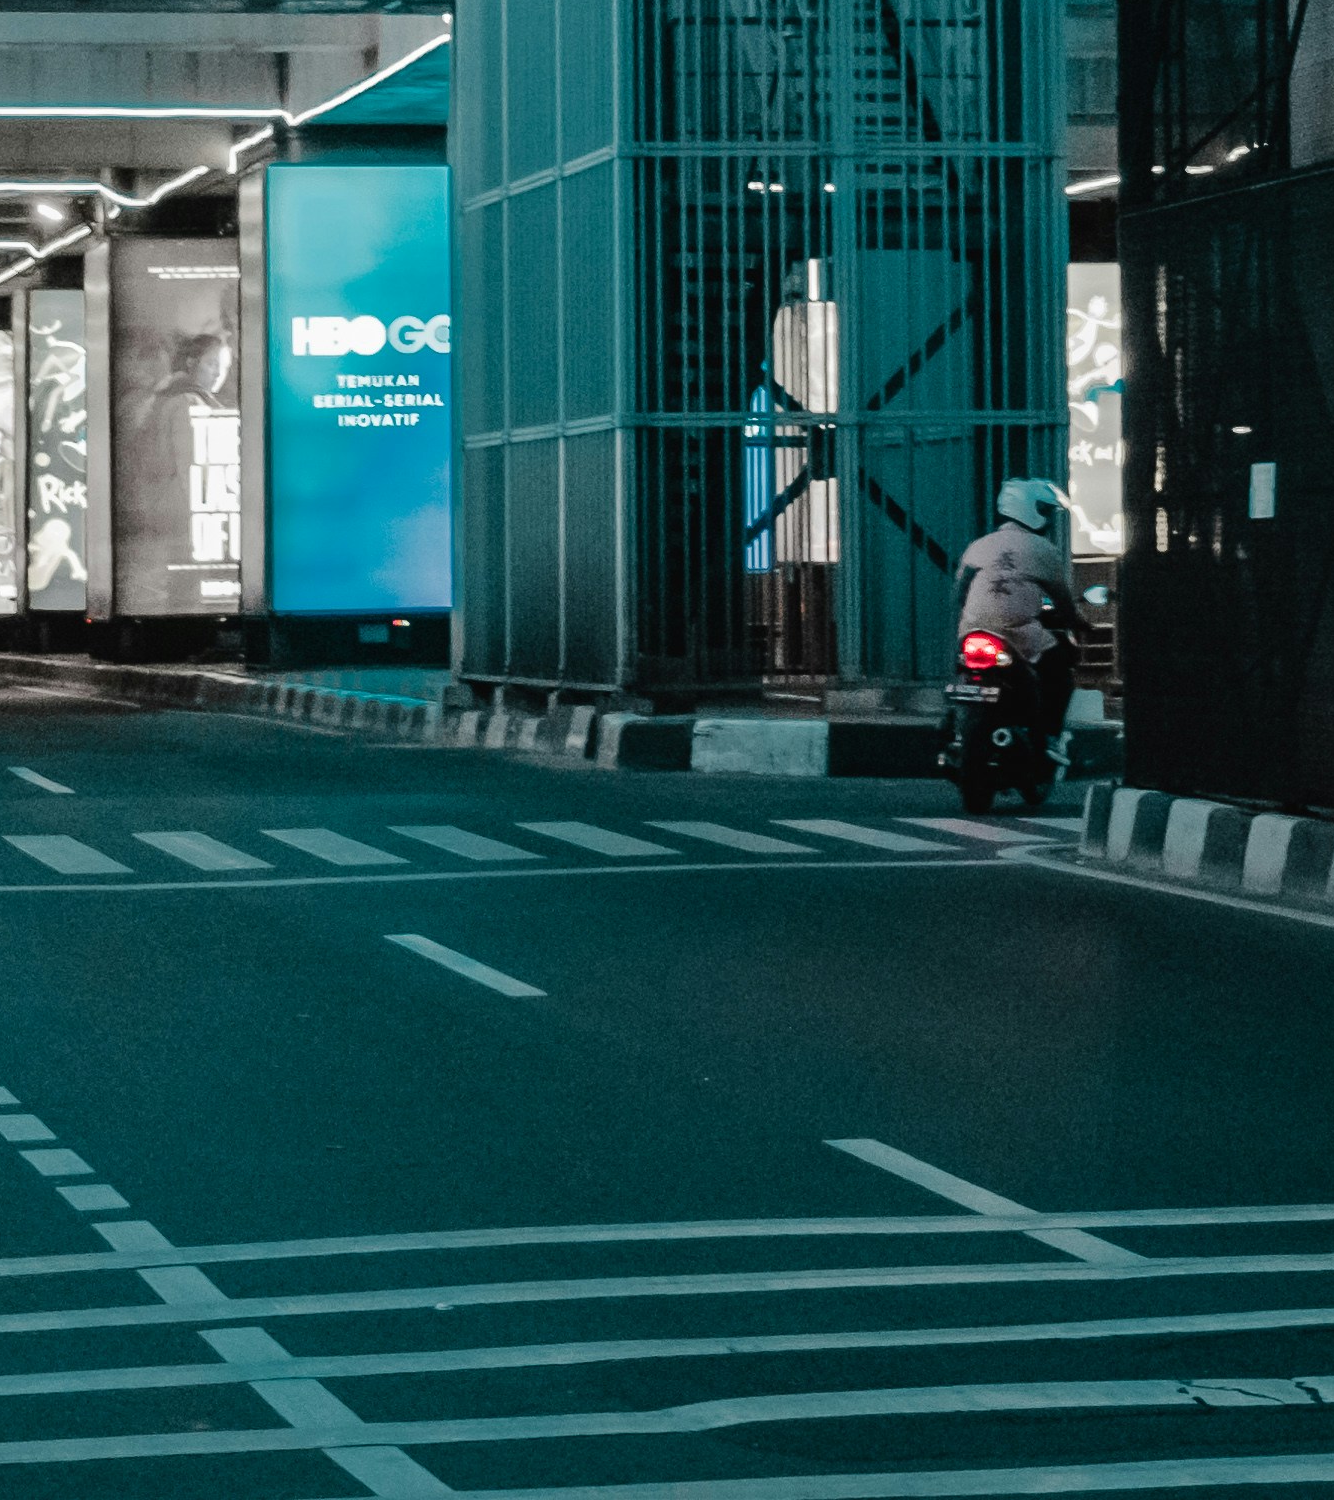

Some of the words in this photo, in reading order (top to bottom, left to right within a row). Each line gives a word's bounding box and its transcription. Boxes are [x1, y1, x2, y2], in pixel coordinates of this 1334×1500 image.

[292, 314, 386, 356] HBO
[336, 374, 419, 388] TEMUKAN
[312, 393, 444, 408] SERIAL-SERIAL
[337, 412, 420, 428] INOVATIF
